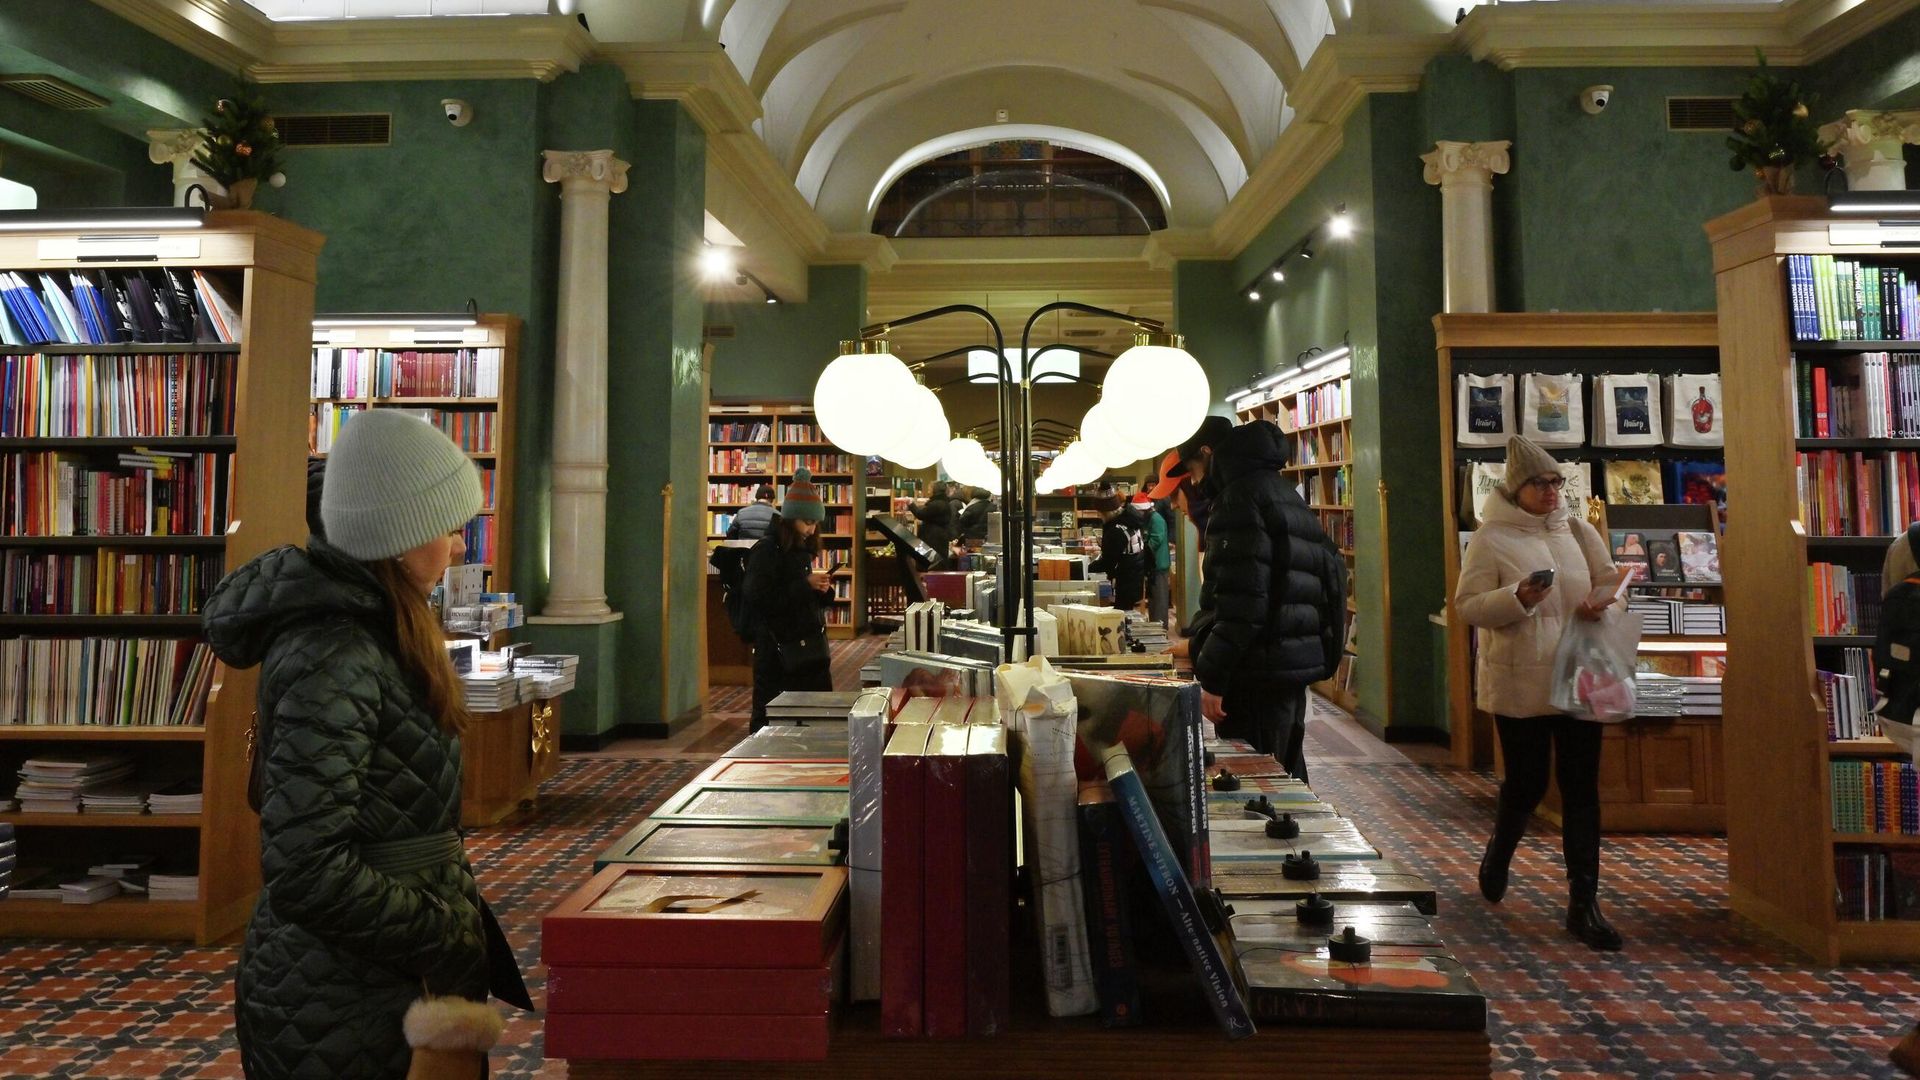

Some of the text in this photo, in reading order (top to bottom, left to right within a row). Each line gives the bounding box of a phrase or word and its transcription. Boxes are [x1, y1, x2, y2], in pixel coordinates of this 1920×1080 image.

[1189, 784, 1197, 834] HAPPEN
[1200, 781, 1208, 830] HAPPEN
[1127, 796, 1155, 850] MARTINE
[1152, 849, 1180, 896] SITBON
[1180, 910, 1212, 971] Alternative
[1208, 970, 1229, 1009] Vision
